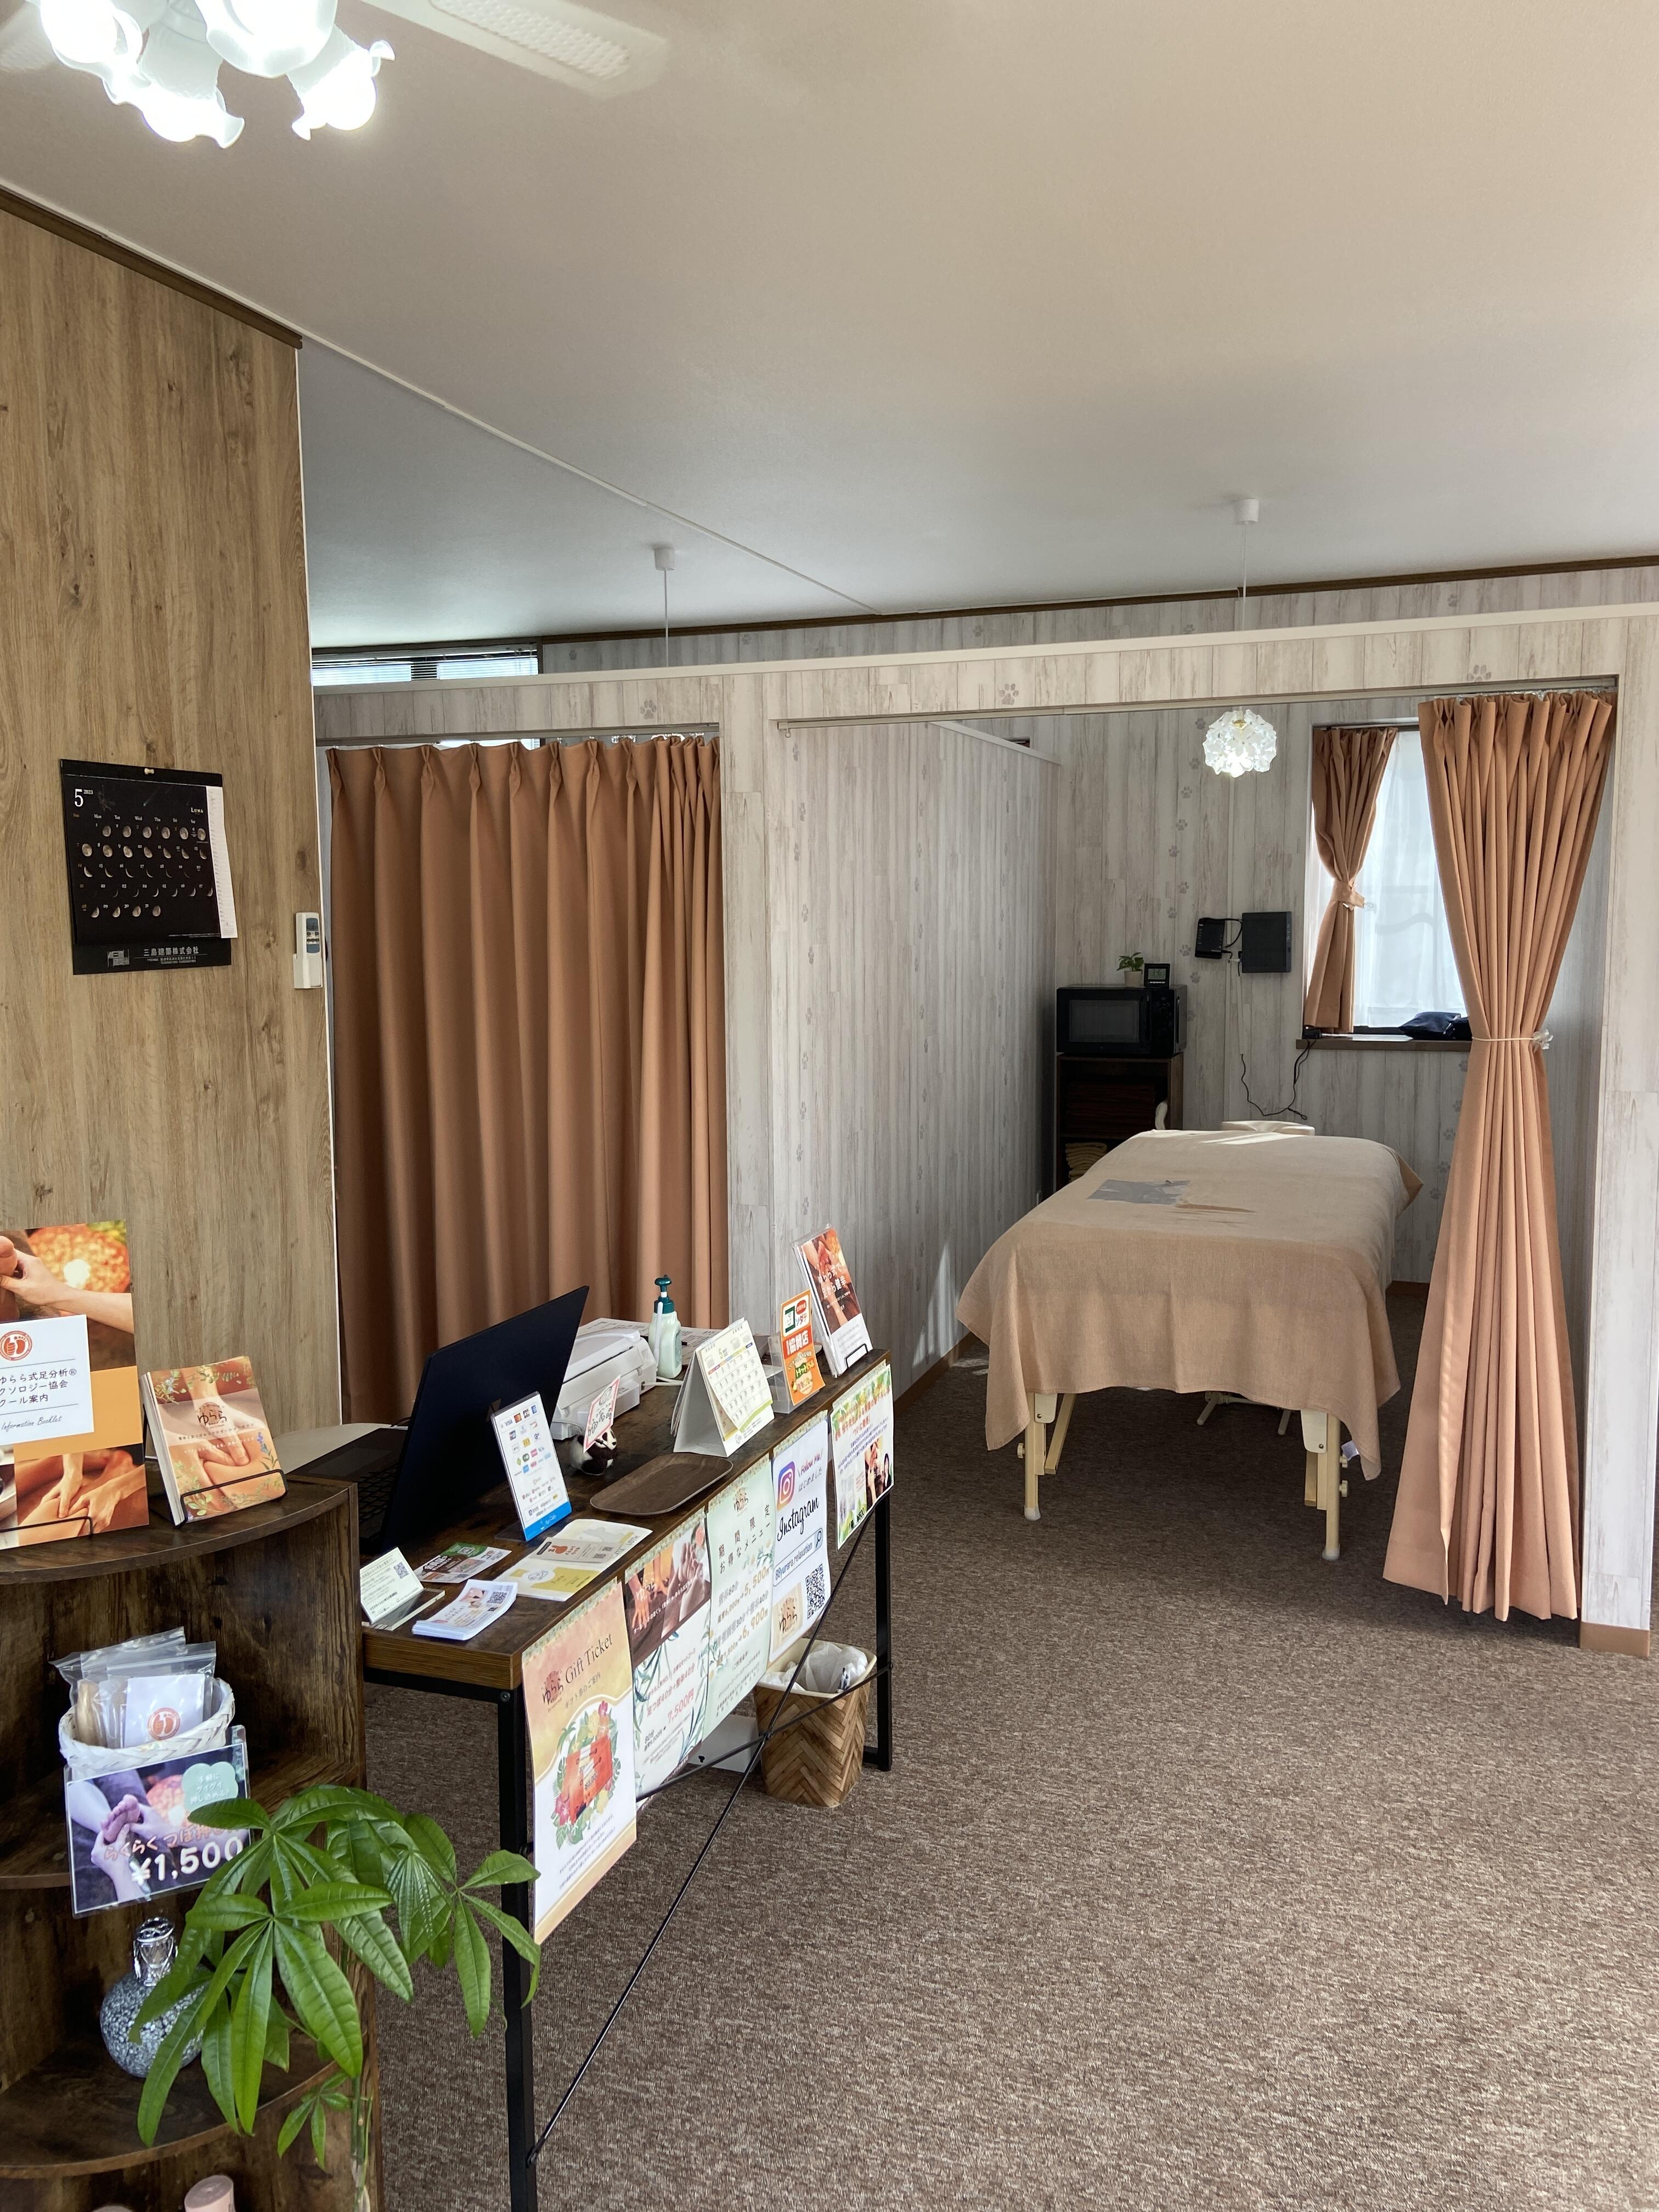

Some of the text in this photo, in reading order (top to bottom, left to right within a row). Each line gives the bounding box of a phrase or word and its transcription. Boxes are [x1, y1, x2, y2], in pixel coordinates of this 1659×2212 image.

[75, 789, 83, 806] 5
[786, 1330, 809, 1356] 協賛店
[2, 1415, 63, 1432] Information Booklet
[198, 1409, 227, 1425] ゆらら
[799, 1469, 822, 1492] はじめました
[733, 1492, 749, 1513] ゆらら
[777, 1497, 820, 1542] Instagram
[636, 1582, 657, 1602] ゆらら
[780, 1605, 798, 1634] ゆらら
[543, 1633, 613, 1705] ゆらら Gift Ticket
[668, 1689, 694, 1724] 7,500円
[104, 1835, 159, 1861] らくらく
[131, 1836, 244, 1886] ¥1,500
